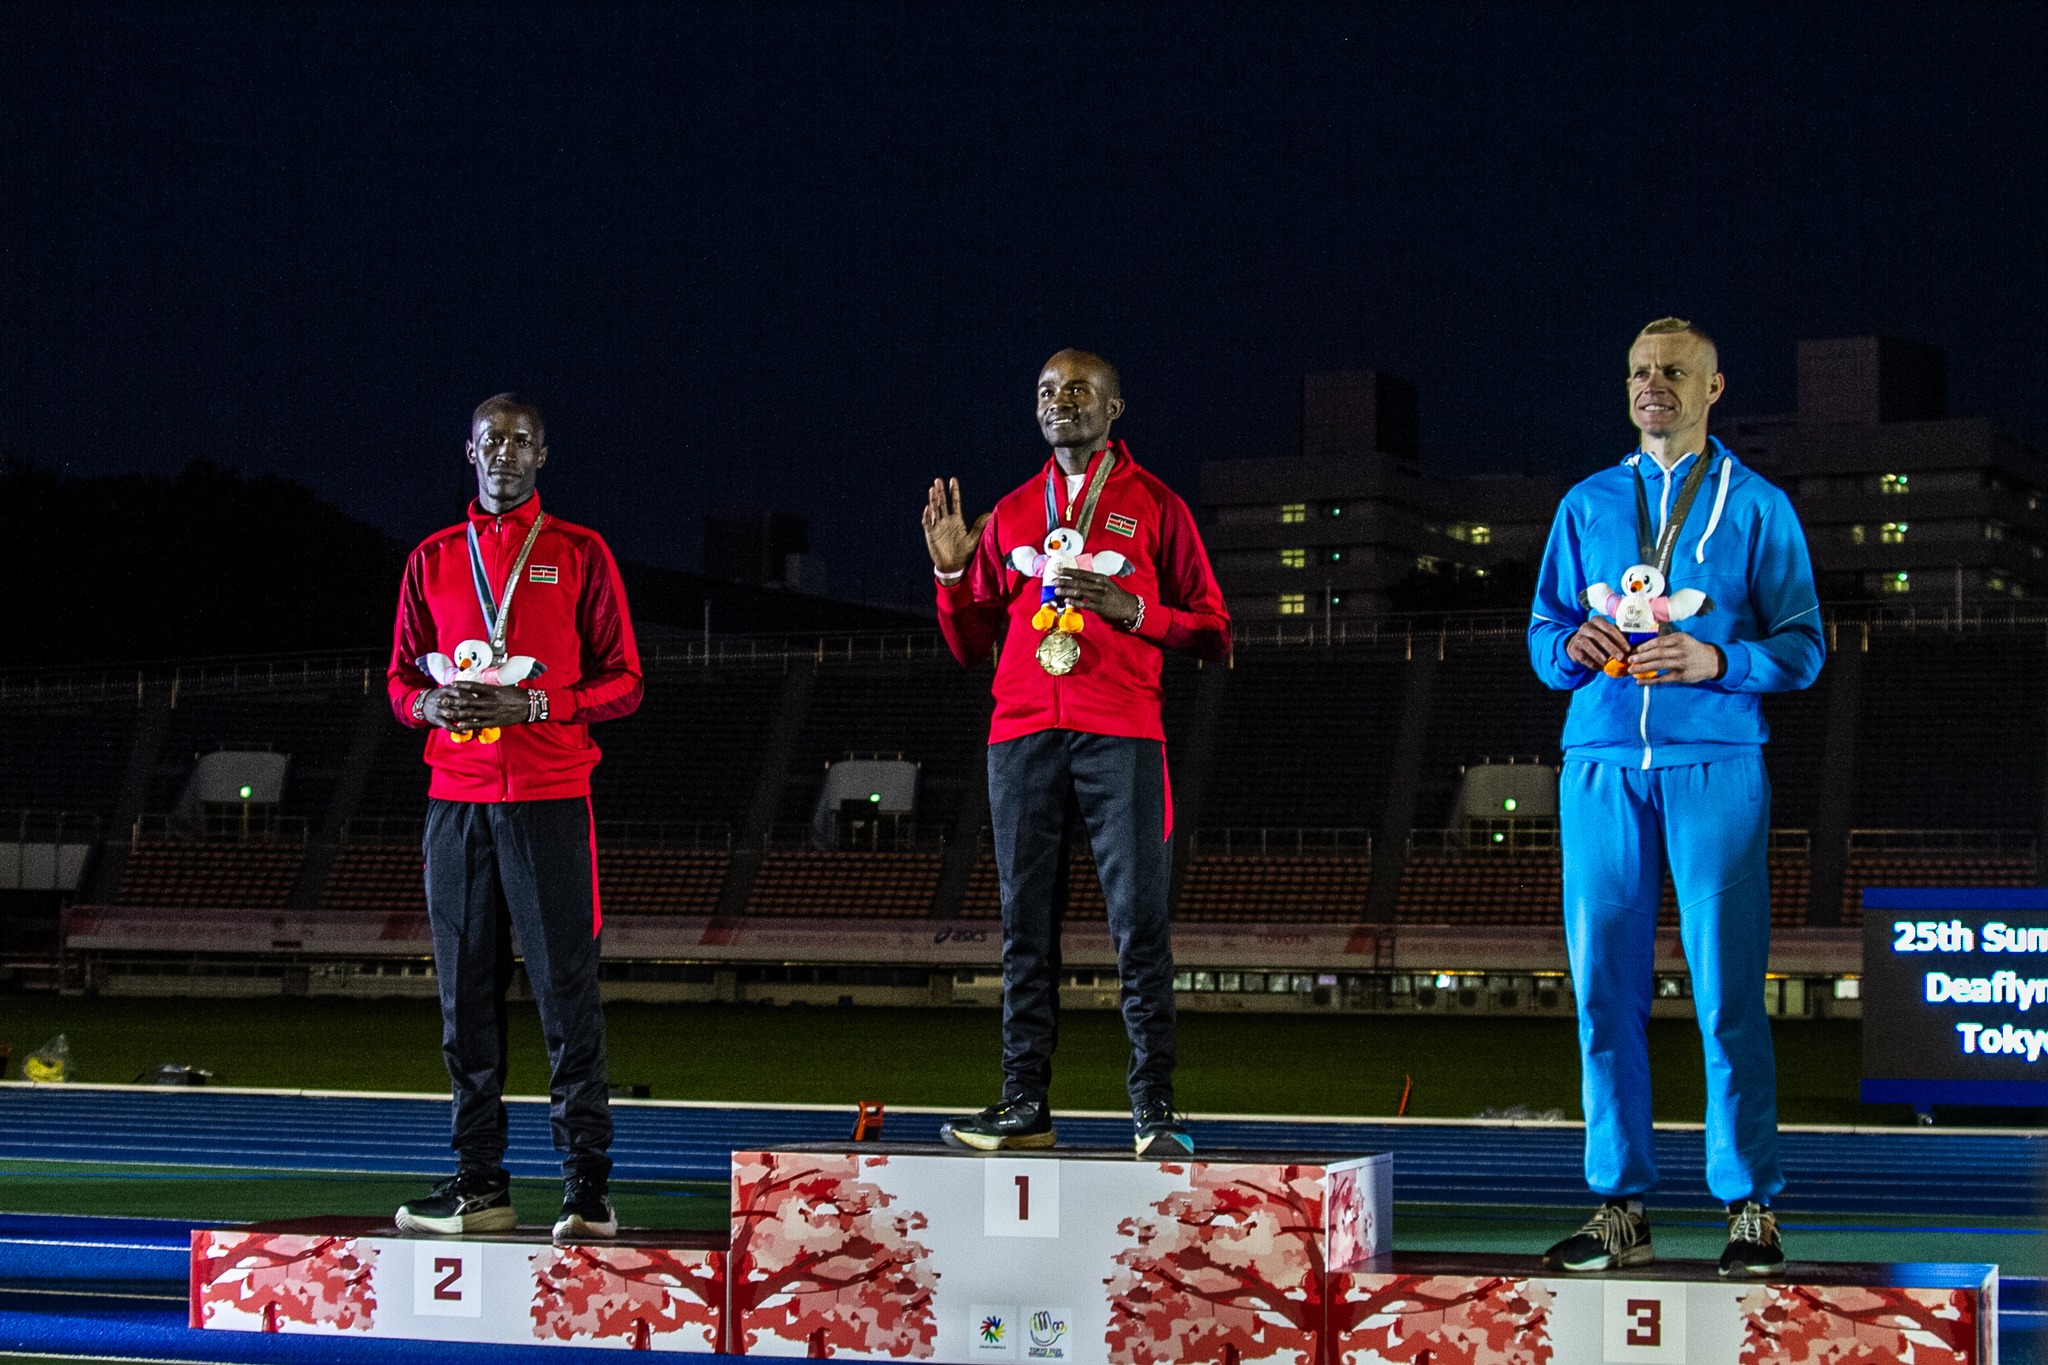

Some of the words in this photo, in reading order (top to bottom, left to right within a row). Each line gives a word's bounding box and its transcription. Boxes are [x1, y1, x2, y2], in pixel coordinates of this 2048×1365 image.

[1893, 920, 1974, 952] 25th
[1015, 1175, 1029, 1220] 1
[434, 1257, 462, 1301] 2
[1627, 1299, 1661, 1346] 3
